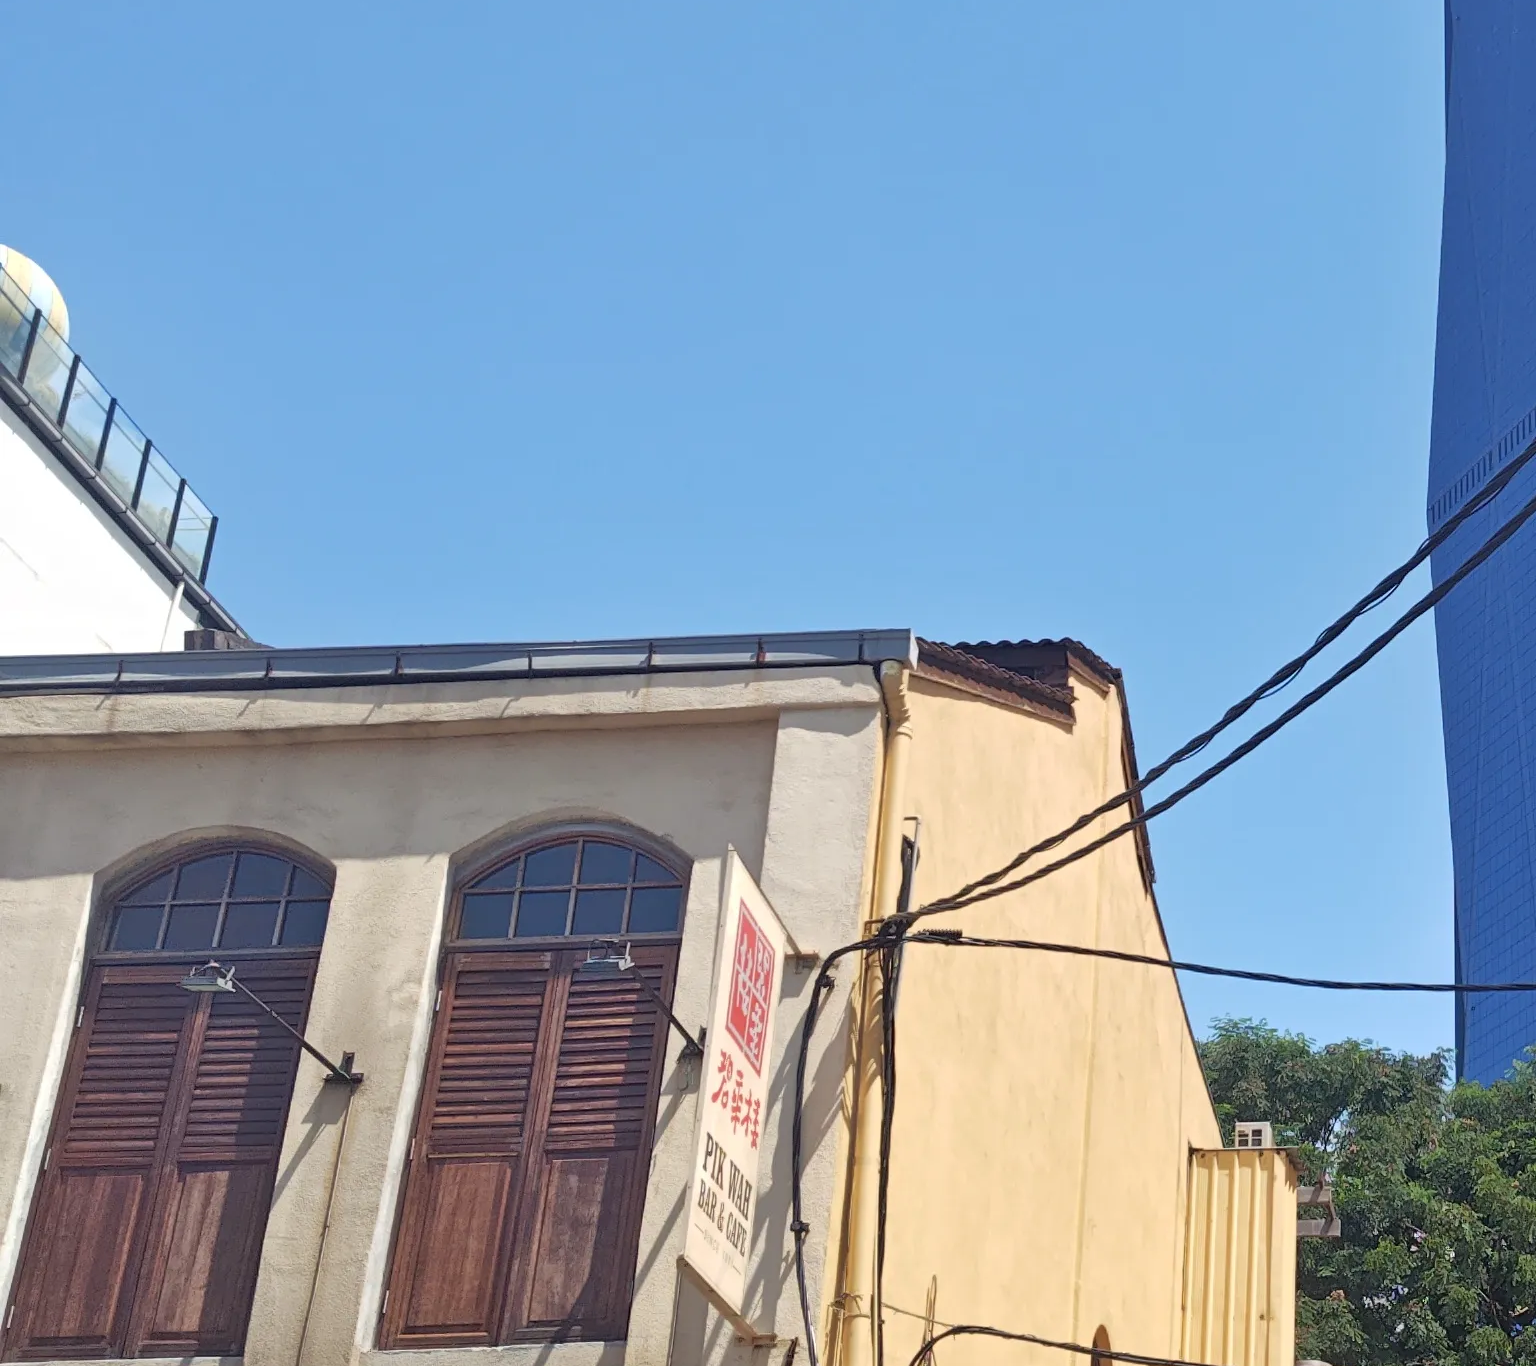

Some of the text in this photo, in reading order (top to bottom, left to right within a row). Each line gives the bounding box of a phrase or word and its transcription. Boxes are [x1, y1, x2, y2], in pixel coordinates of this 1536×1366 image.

[698, 1178, 748, 1257] BAR & CAFE
[702, 1131, 752, 1222] PIK WAH
